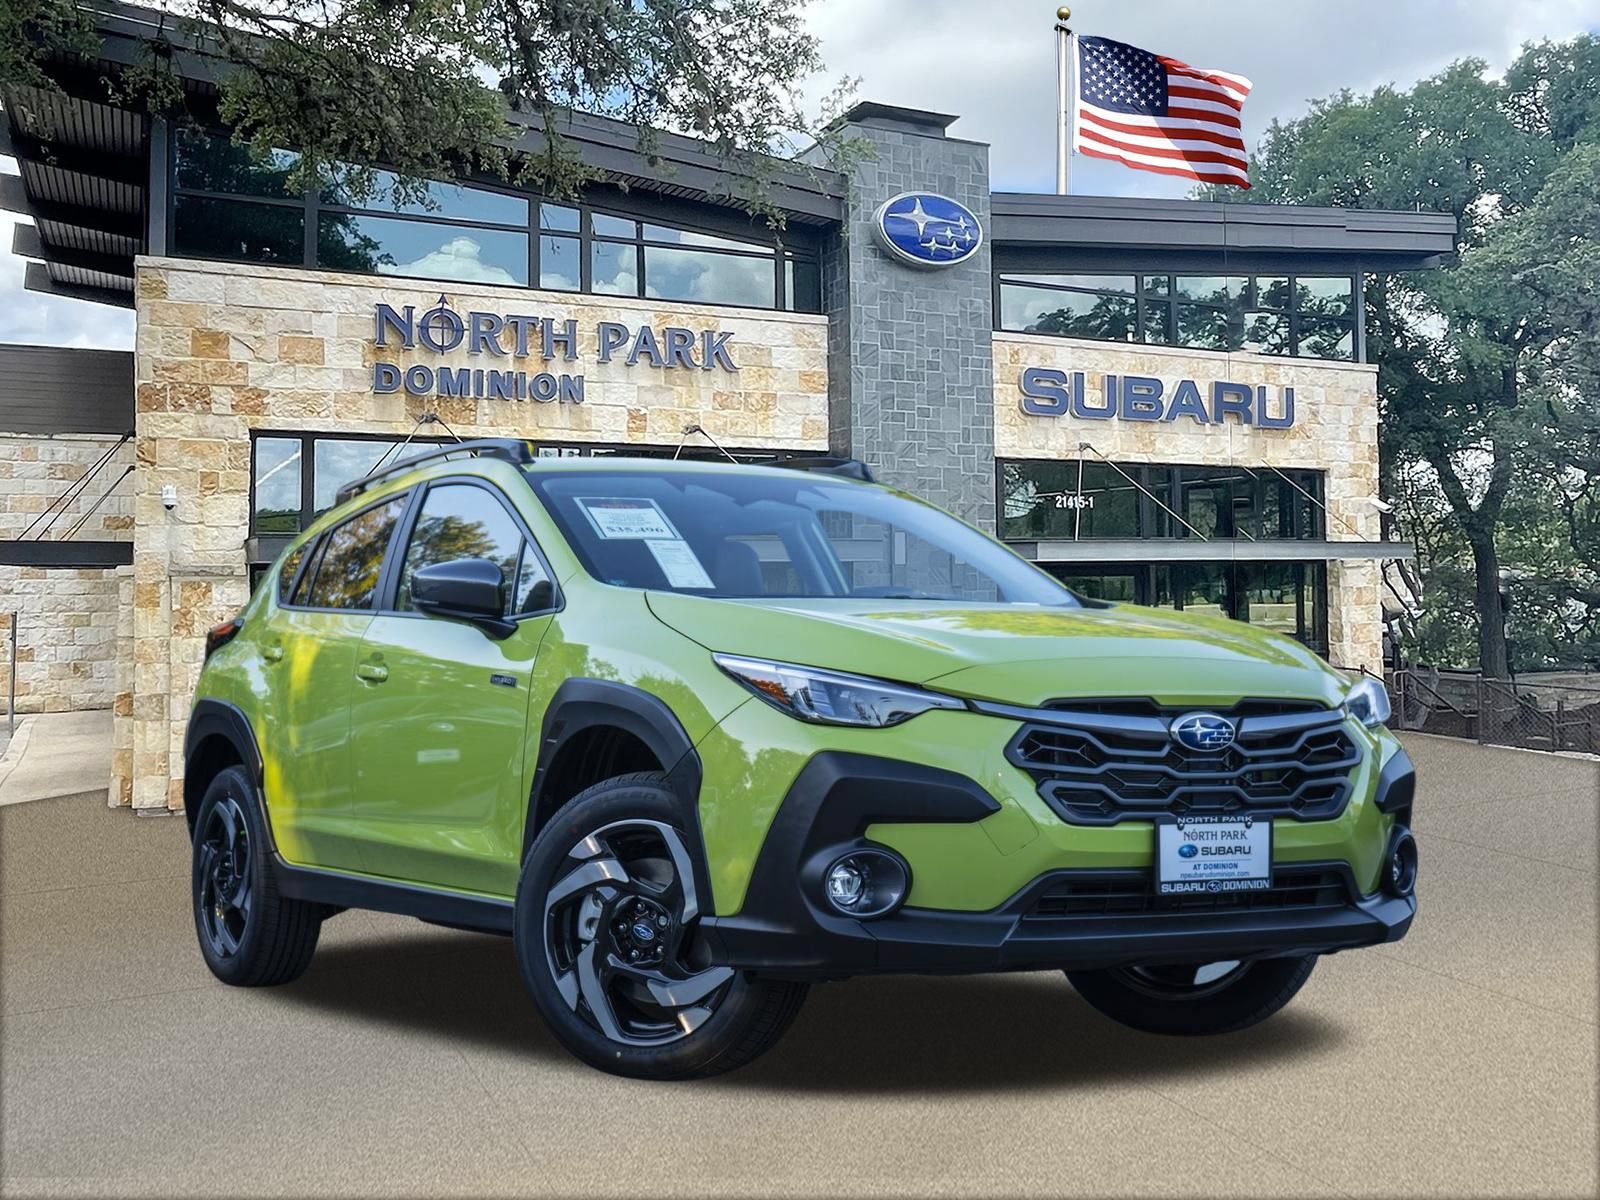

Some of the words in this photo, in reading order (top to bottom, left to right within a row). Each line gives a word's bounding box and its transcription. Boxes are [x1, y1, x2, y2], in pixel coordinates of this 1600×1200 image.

[374, 294, 581, 361] NORTH
[597, 319, 743, 373] PARK
[372, 361, 586, 404] DOMINION
[1019, 366, 1295, 430] SUBARU
[1177, 816, 1218, 824] NORTH
[1222, 815, 1253, 823] PARK
[1183, 829, 1218, 841] NORTH
[1220, 830, 1248, 841] PARK
[1201, 846, 1252, 856] SUBARU
[1192, 863, 1202, 871] AT
[1203, 862, 1239, 871] DOMINION
[1161, 882, 1206, 893] SUBARU
[1222, 879, 1270, 891] DOMINION
